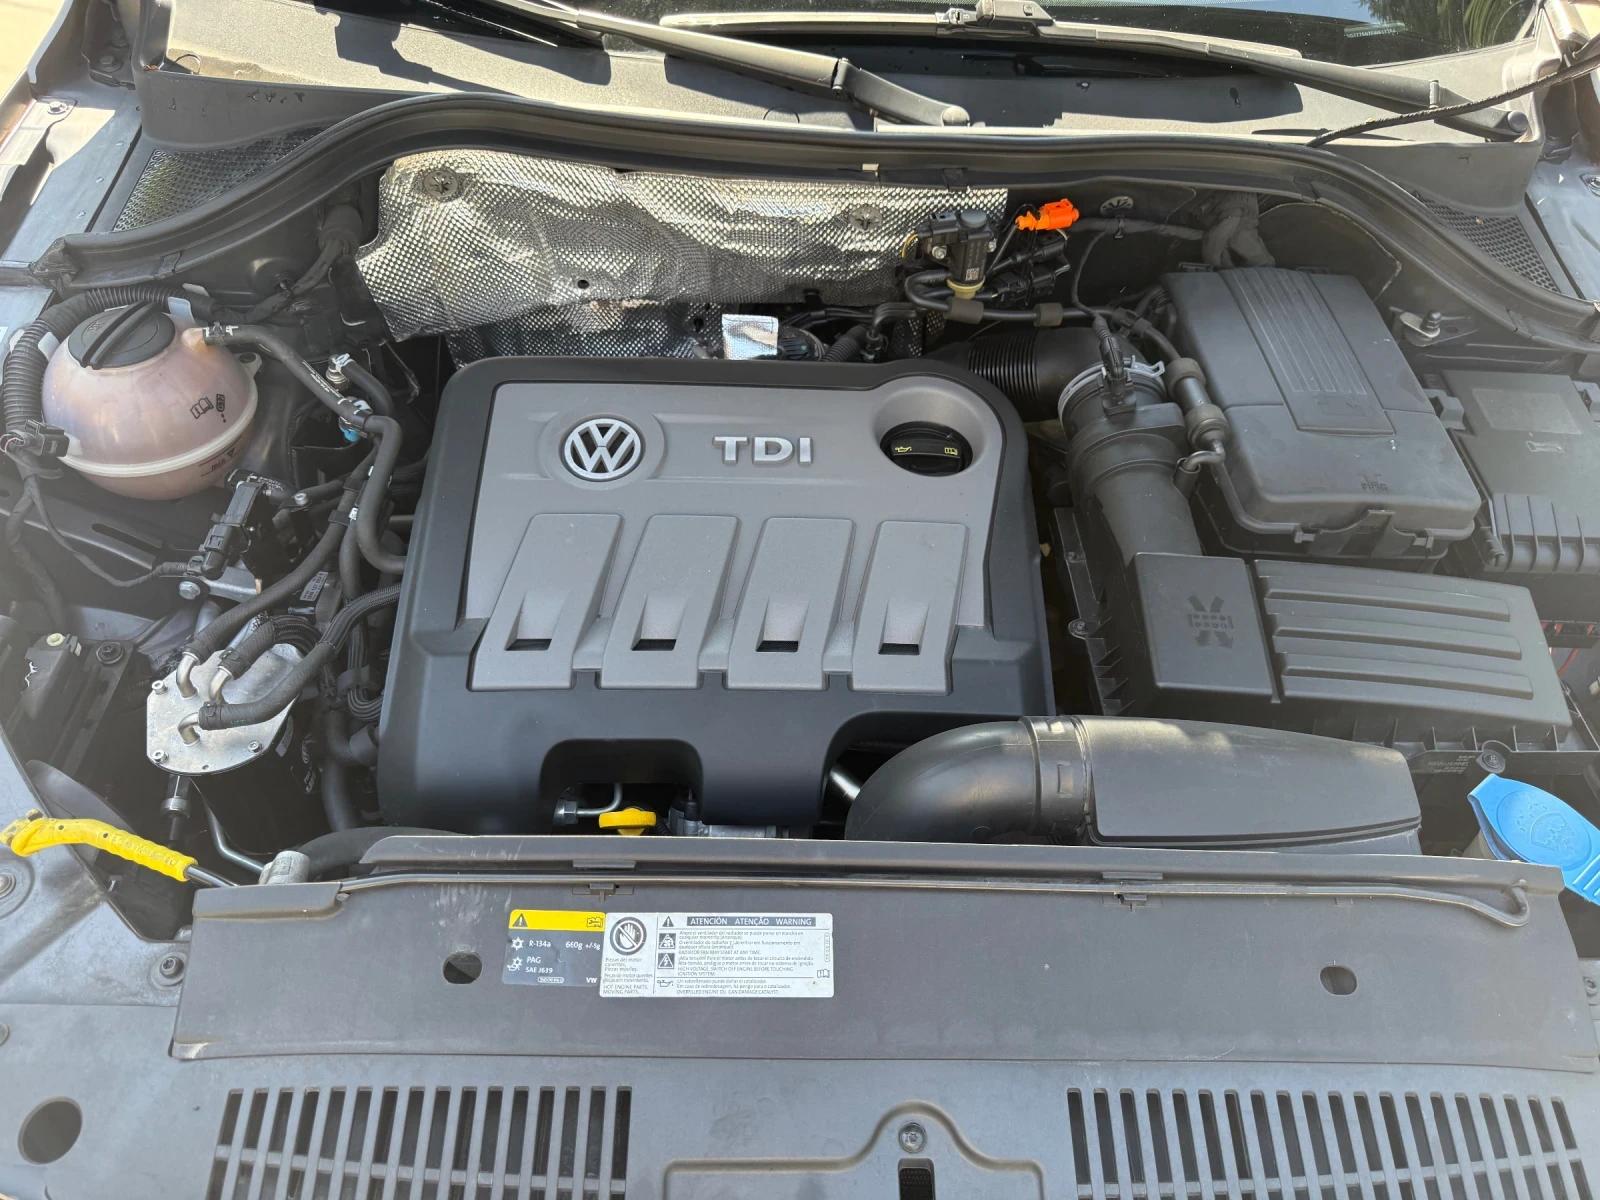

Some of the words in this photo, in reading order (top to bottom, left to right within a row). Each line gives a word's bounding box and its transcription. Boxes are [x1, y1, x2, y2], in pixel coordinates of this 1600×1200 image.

[564, 417, 642, 480] VW
[712, 436, 814, 465] TDI
[212, 458, 226, 470] min
[690, 917, 728, 925] ATENCIÓN
[734, 917, 769, 926] ATENÇÃO
